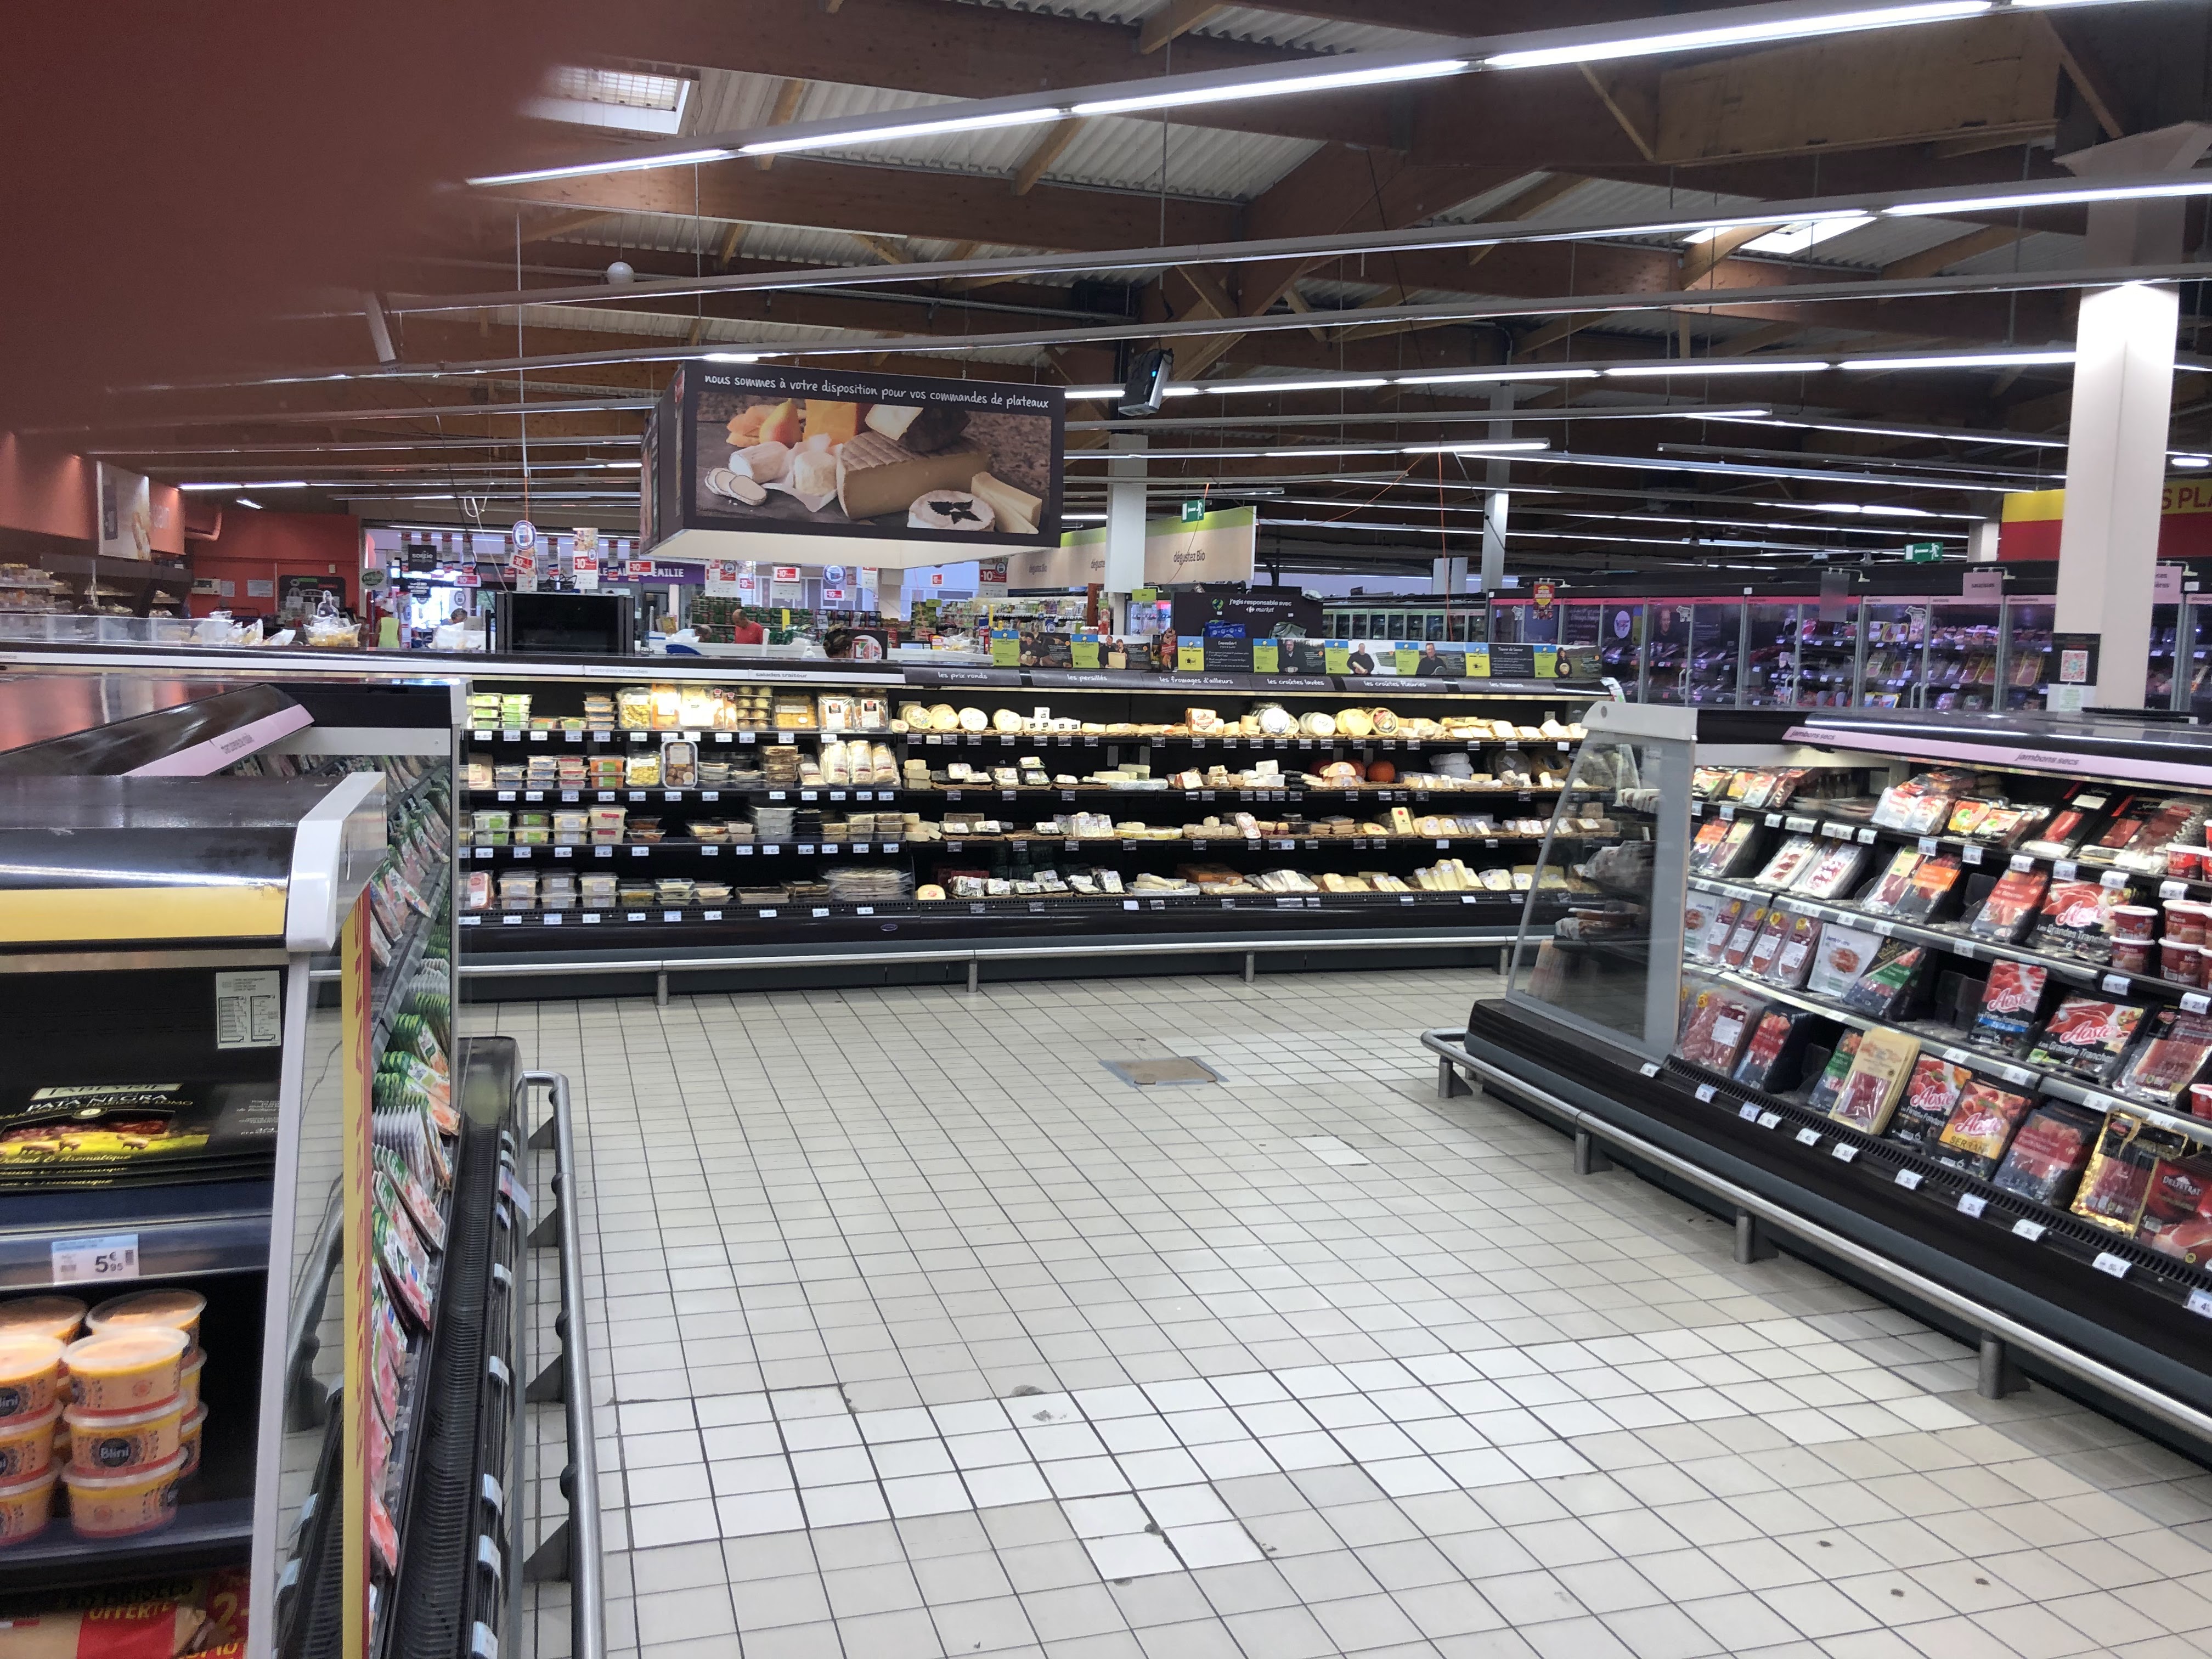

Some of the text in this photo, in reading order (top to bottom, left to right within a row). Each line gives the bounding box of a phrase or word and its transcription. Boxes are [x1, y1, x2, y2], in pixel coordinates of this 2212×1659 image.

[705, 374, 1049, 409] nous sommes à votre disposition pour vos commandes de plateaux
[2178, 486, 2212, 509] PL
[1091, 558, 1105, 571] déguste
[1173, 550, 1205, 566] dégustez Bio
[652, 568, 684, 578] EMILIE
[1171, 676, 1202, 685] fromages
[1789, 730, 1819, 740] jambons
[2015, 752, 2079, 766] jambons secs
[2078, 930, 2112, 947] Tranche
[1910, 1085, 1957, 1111] Aoste
